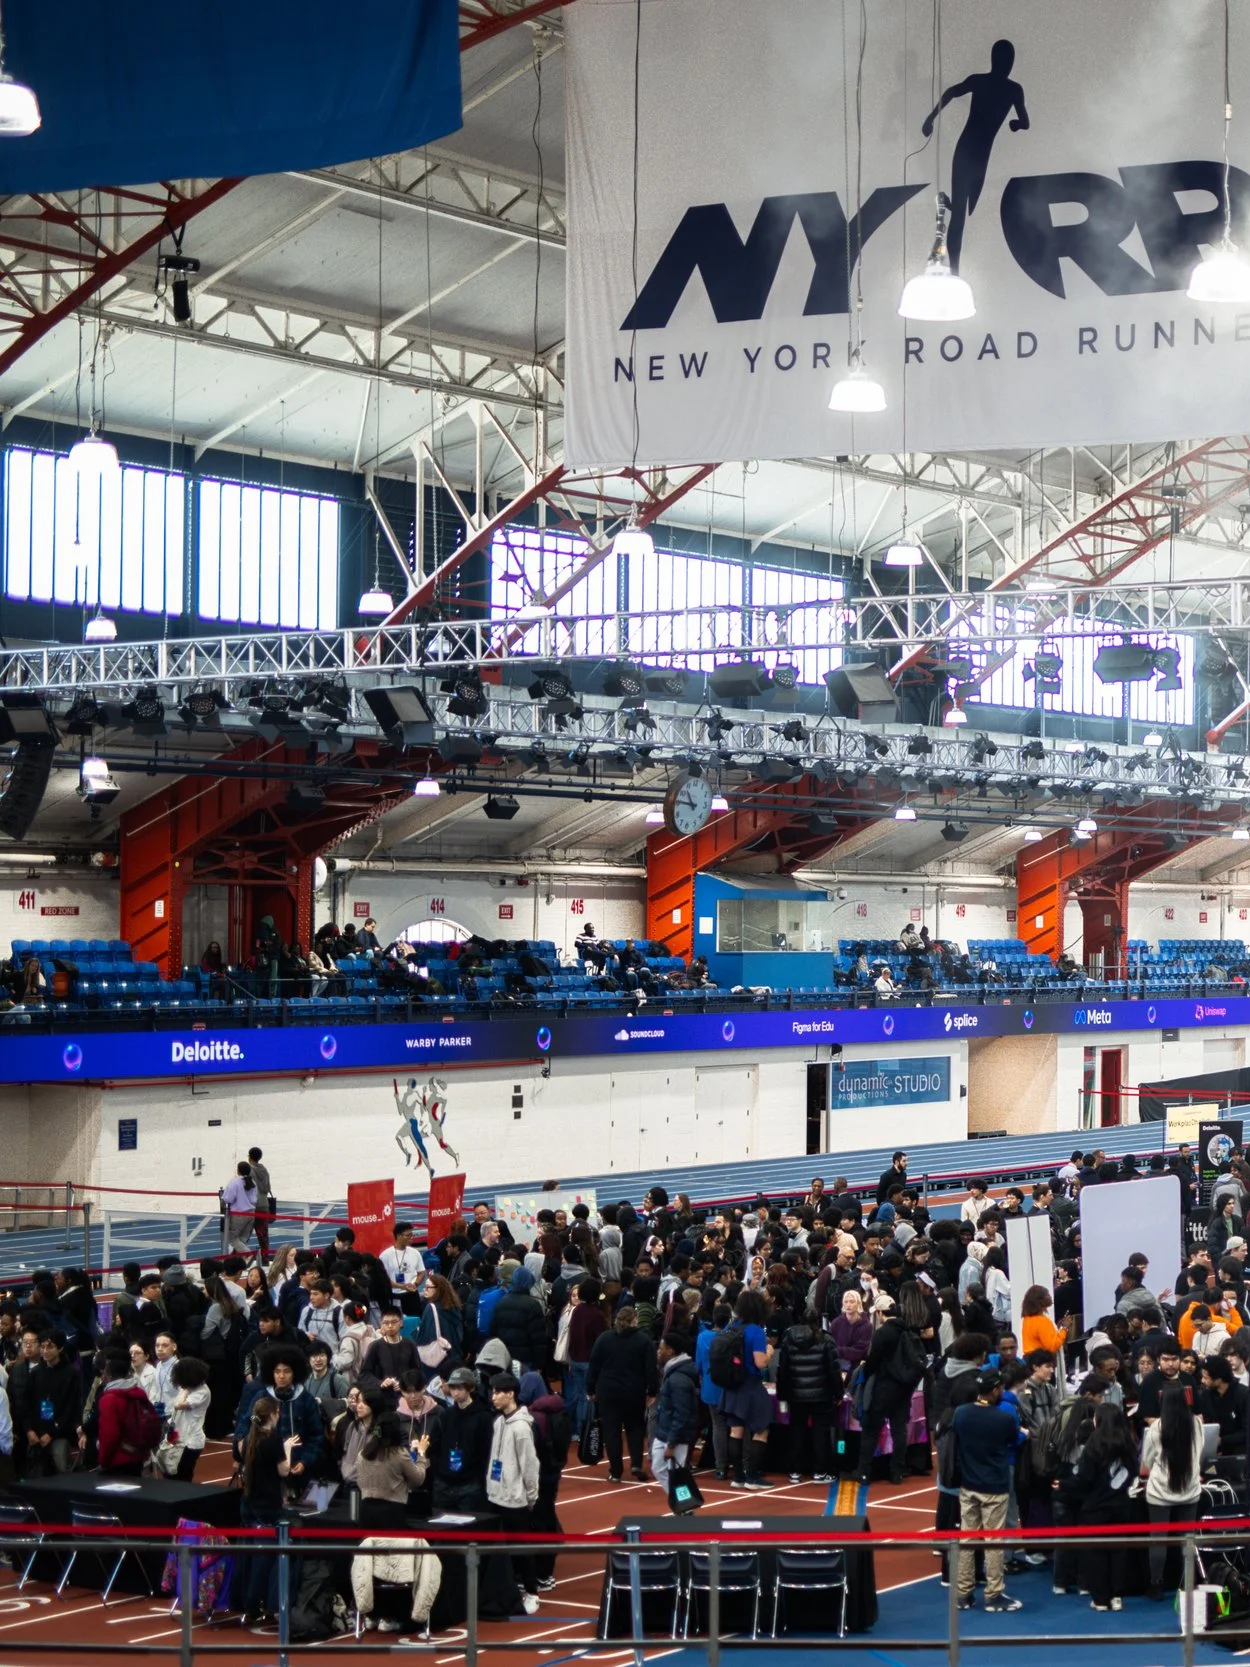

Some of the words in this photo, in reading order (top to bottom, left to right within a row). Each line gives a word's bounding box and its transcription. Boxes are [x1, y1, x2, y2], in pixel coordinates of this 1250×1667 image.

[614, 351, 709, 384] NEW
[743, 340, 868, 375] YORK
[905, 331, 1039, 365] ROAD
[18, 890, 35, 909] 411
[430, 898, 445, 914] 414
[44, 907, 58, 915] RED
[60, 907, 76, 915] ZONE
[357, 904, 368, 913] EXIT
[501, 906, 512, 915] EXIT
[571, 899, 584, 915] 415
[856, 903, 868, 917] 418
[956, 904, 966, 918] 419
[1087, 1009, 1111, 1024] Meta
[1204, 1006, 1227, 1018] Uniswap
[792, 1022, 811, 1034] Figma
[812, 1021, 820, 1032] for
[821, 1020, 834, 1031] Edu
[953, 1013, 978, 1029] splice
[630, 1029, 665, 1039] SOUNDCLOUD
[406, 1038, 436, 1048] WARBY
[439, 1036, 472, 1047] PARKER
[172, 1040, 245, 1063] Deloitte.
[838, 1073, 889, 1103] dynamic
[894, 1074, 941, 1093] STUDIO
[838, 1091, 889, 1101] PRODUCTIONS
